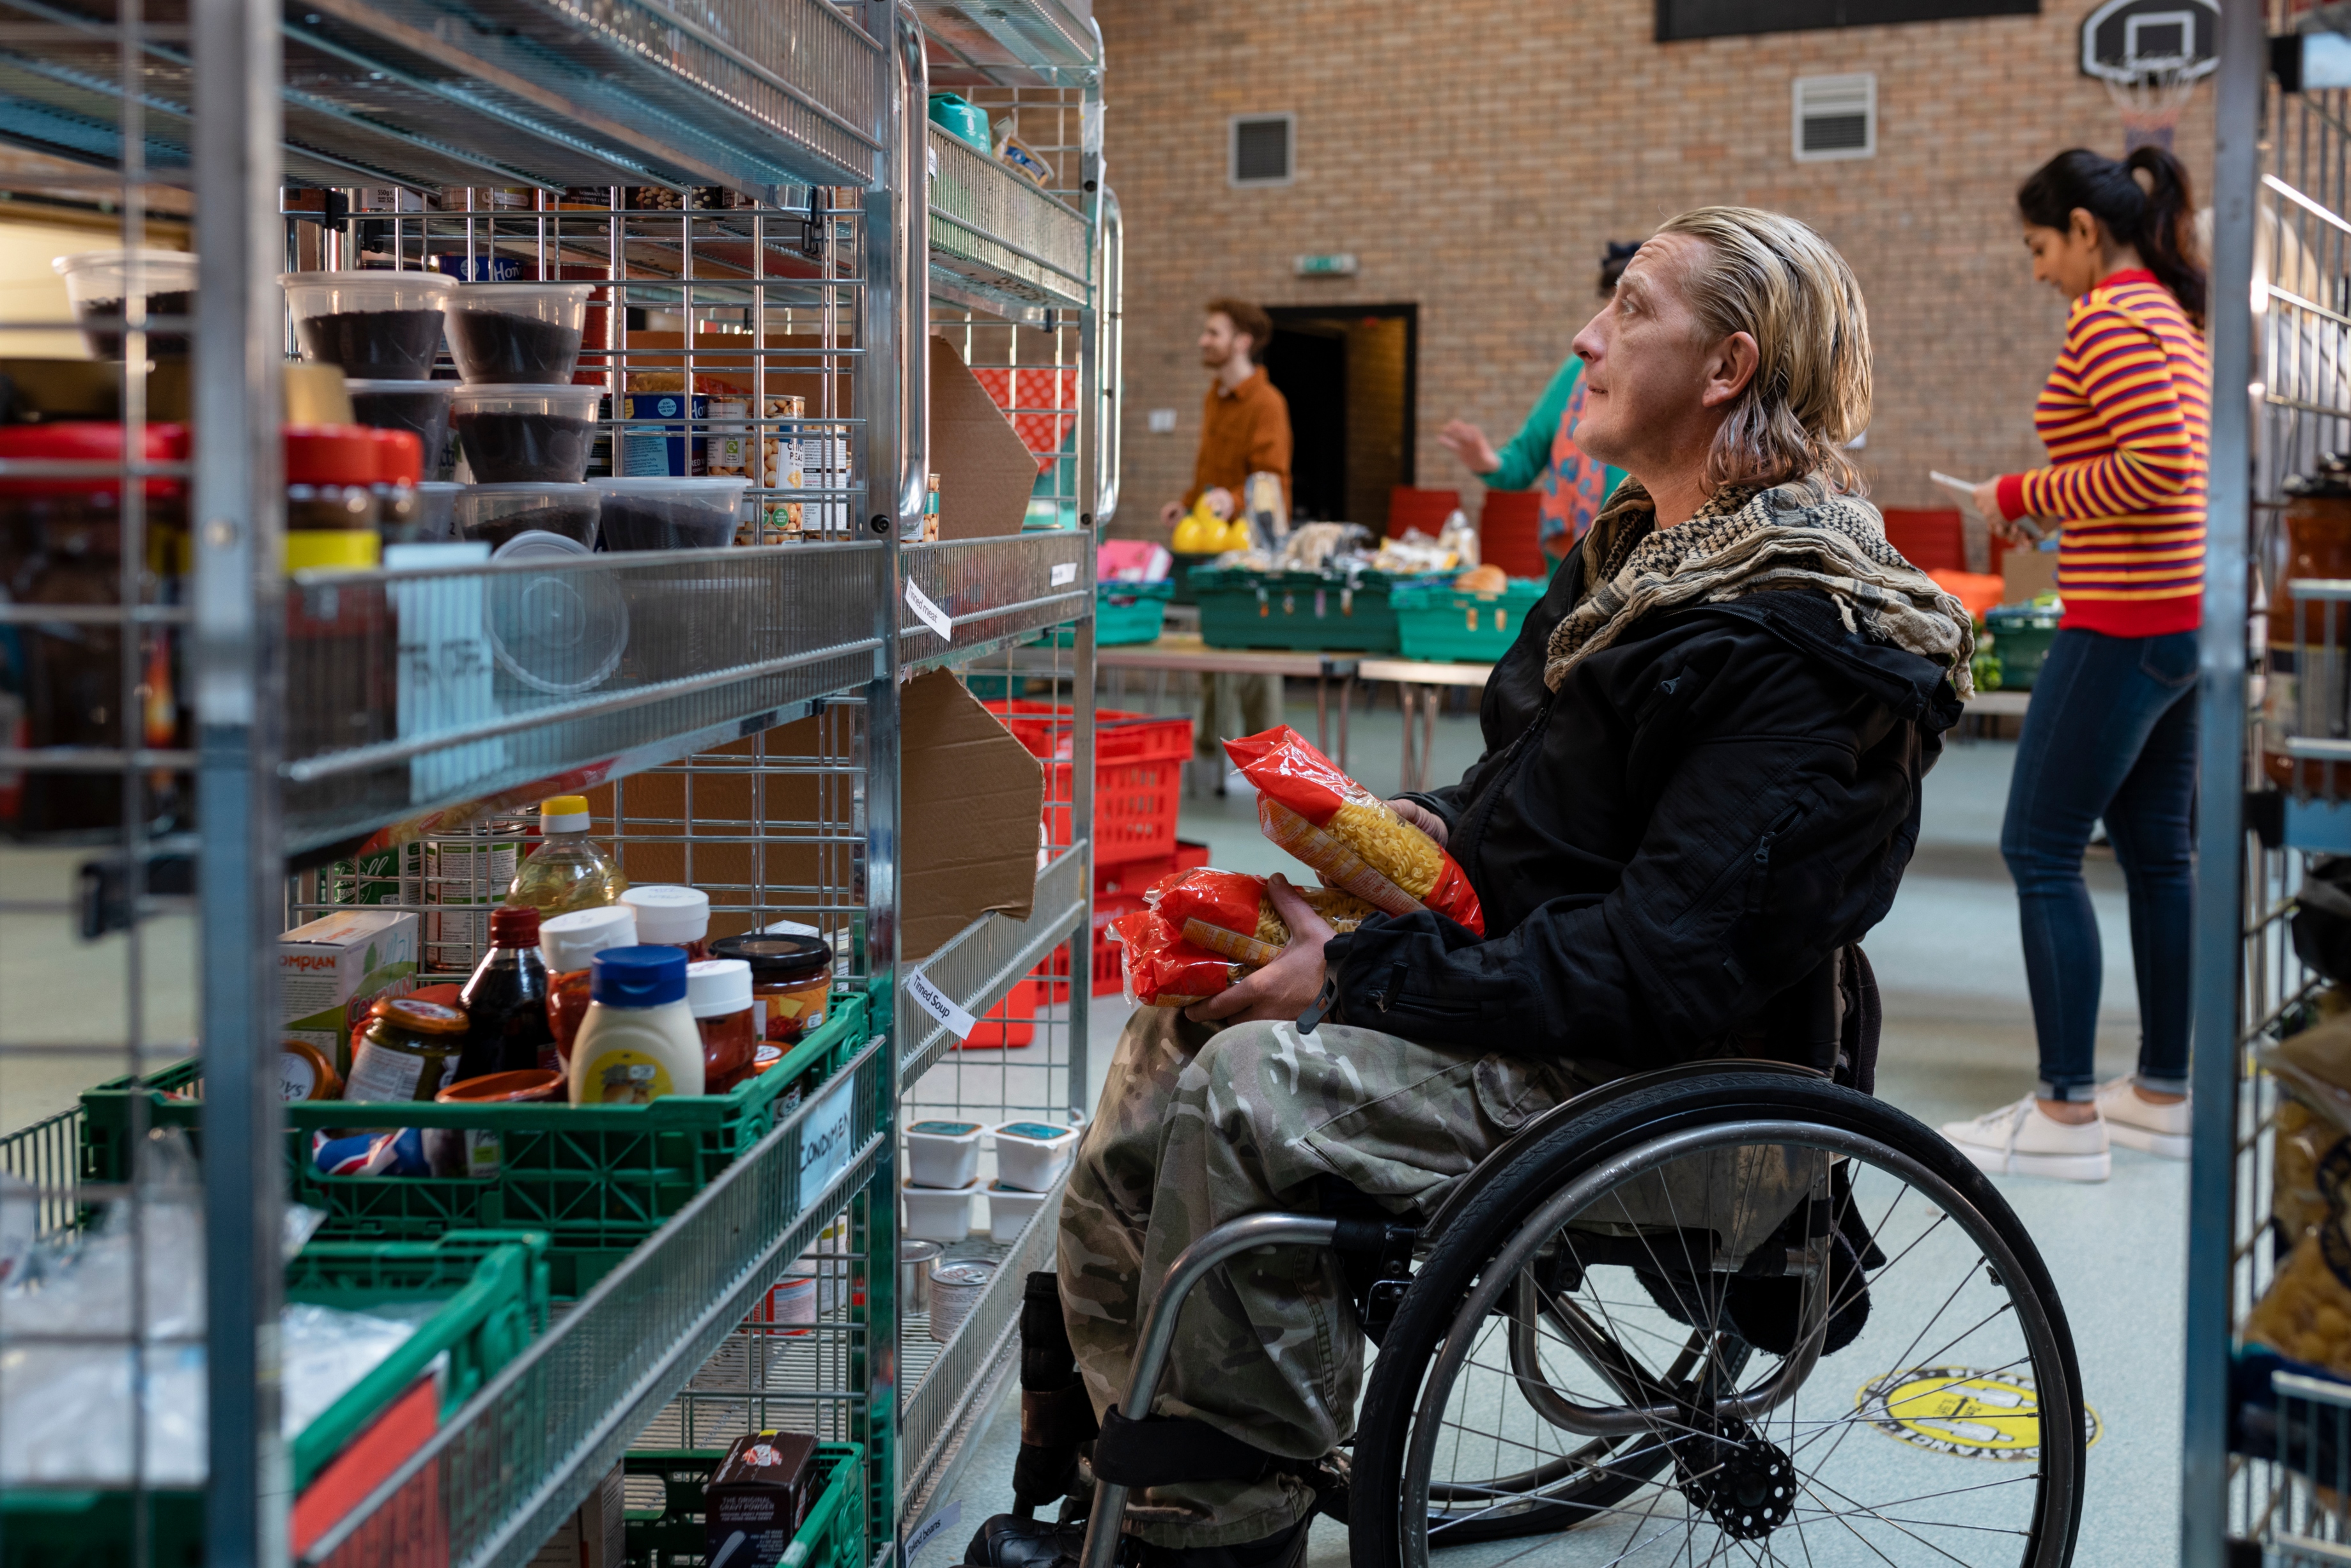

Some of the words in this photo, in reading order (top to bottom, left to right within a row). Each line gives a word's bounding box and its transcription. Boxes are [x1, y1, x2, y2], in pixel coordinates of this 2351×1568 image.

[787, 442, 803, 452] CHIC
[909, 584, 923, 610] Tinned
[923, 604, 938, 624] meat
[1372, 884, 1385, 895] 500g
[277, 955, 336, 971] OMPLAN
[913, 974, 933, 1001] Tinned
[930, 994, 950, 1018] Soup
[1946, 1368, 2036, 1391] PLEAS
[723, 1496, 736, 1504] THE
[737, 1495, 771, 1504] ORIGINAL
[744, 1503, 775, 1511] POWDER
[908, 1532, 922, 1558] Baked
[923, 1519, 941, 1540] beans
